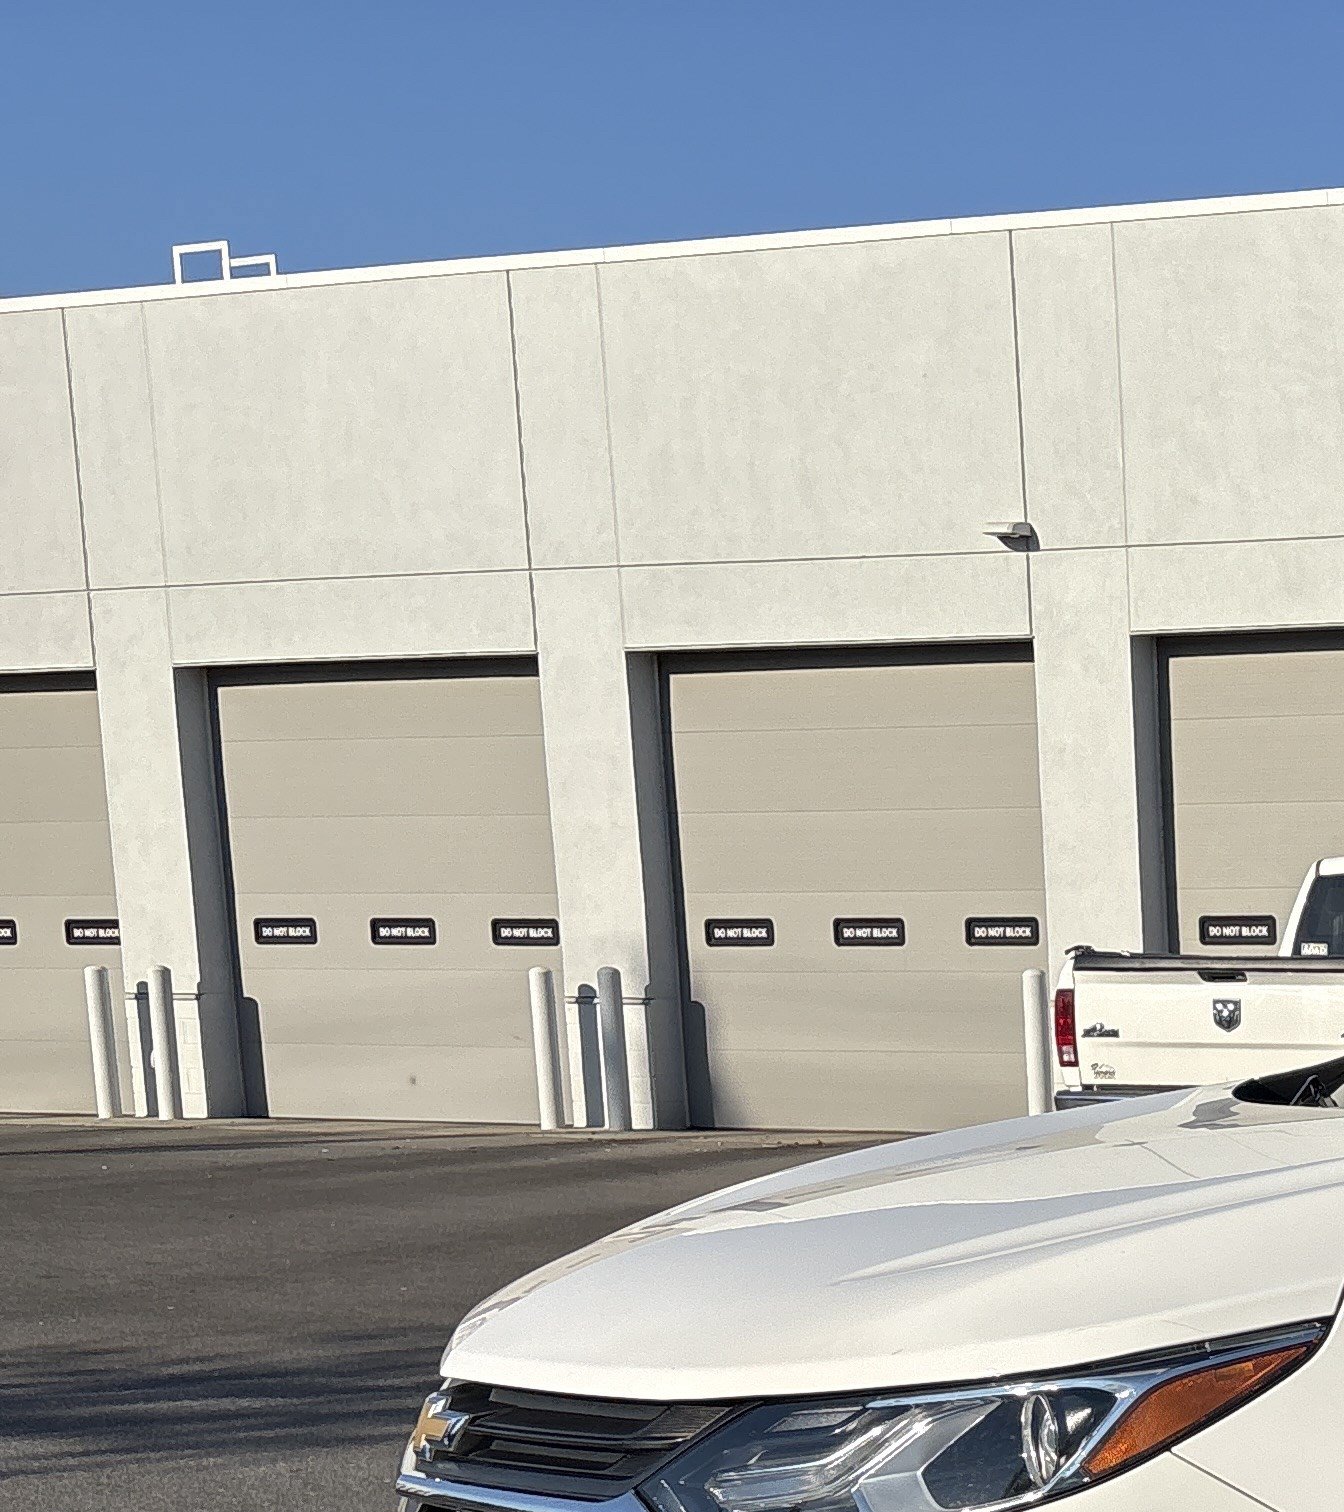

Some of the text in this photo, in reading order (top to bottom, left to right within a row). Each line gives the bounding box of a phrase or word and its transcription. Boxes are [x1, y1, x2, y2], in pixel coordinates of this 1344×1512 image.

[262, 926, 311, 937] DO NOT BLOCK
[379, 926, 430, 938] DO NOT BLOCK
[501, 927, 554, 938] DO NOT BLOCK
[714, 927, 768, 939] DO NOT BLOCK
[843, 927, 899, 938] DO NOT BLOCK
[975, 926, 1032, 938] DO NOT BLOCK
[1209, 925, 1269, 937] DO NOT BLOCK
